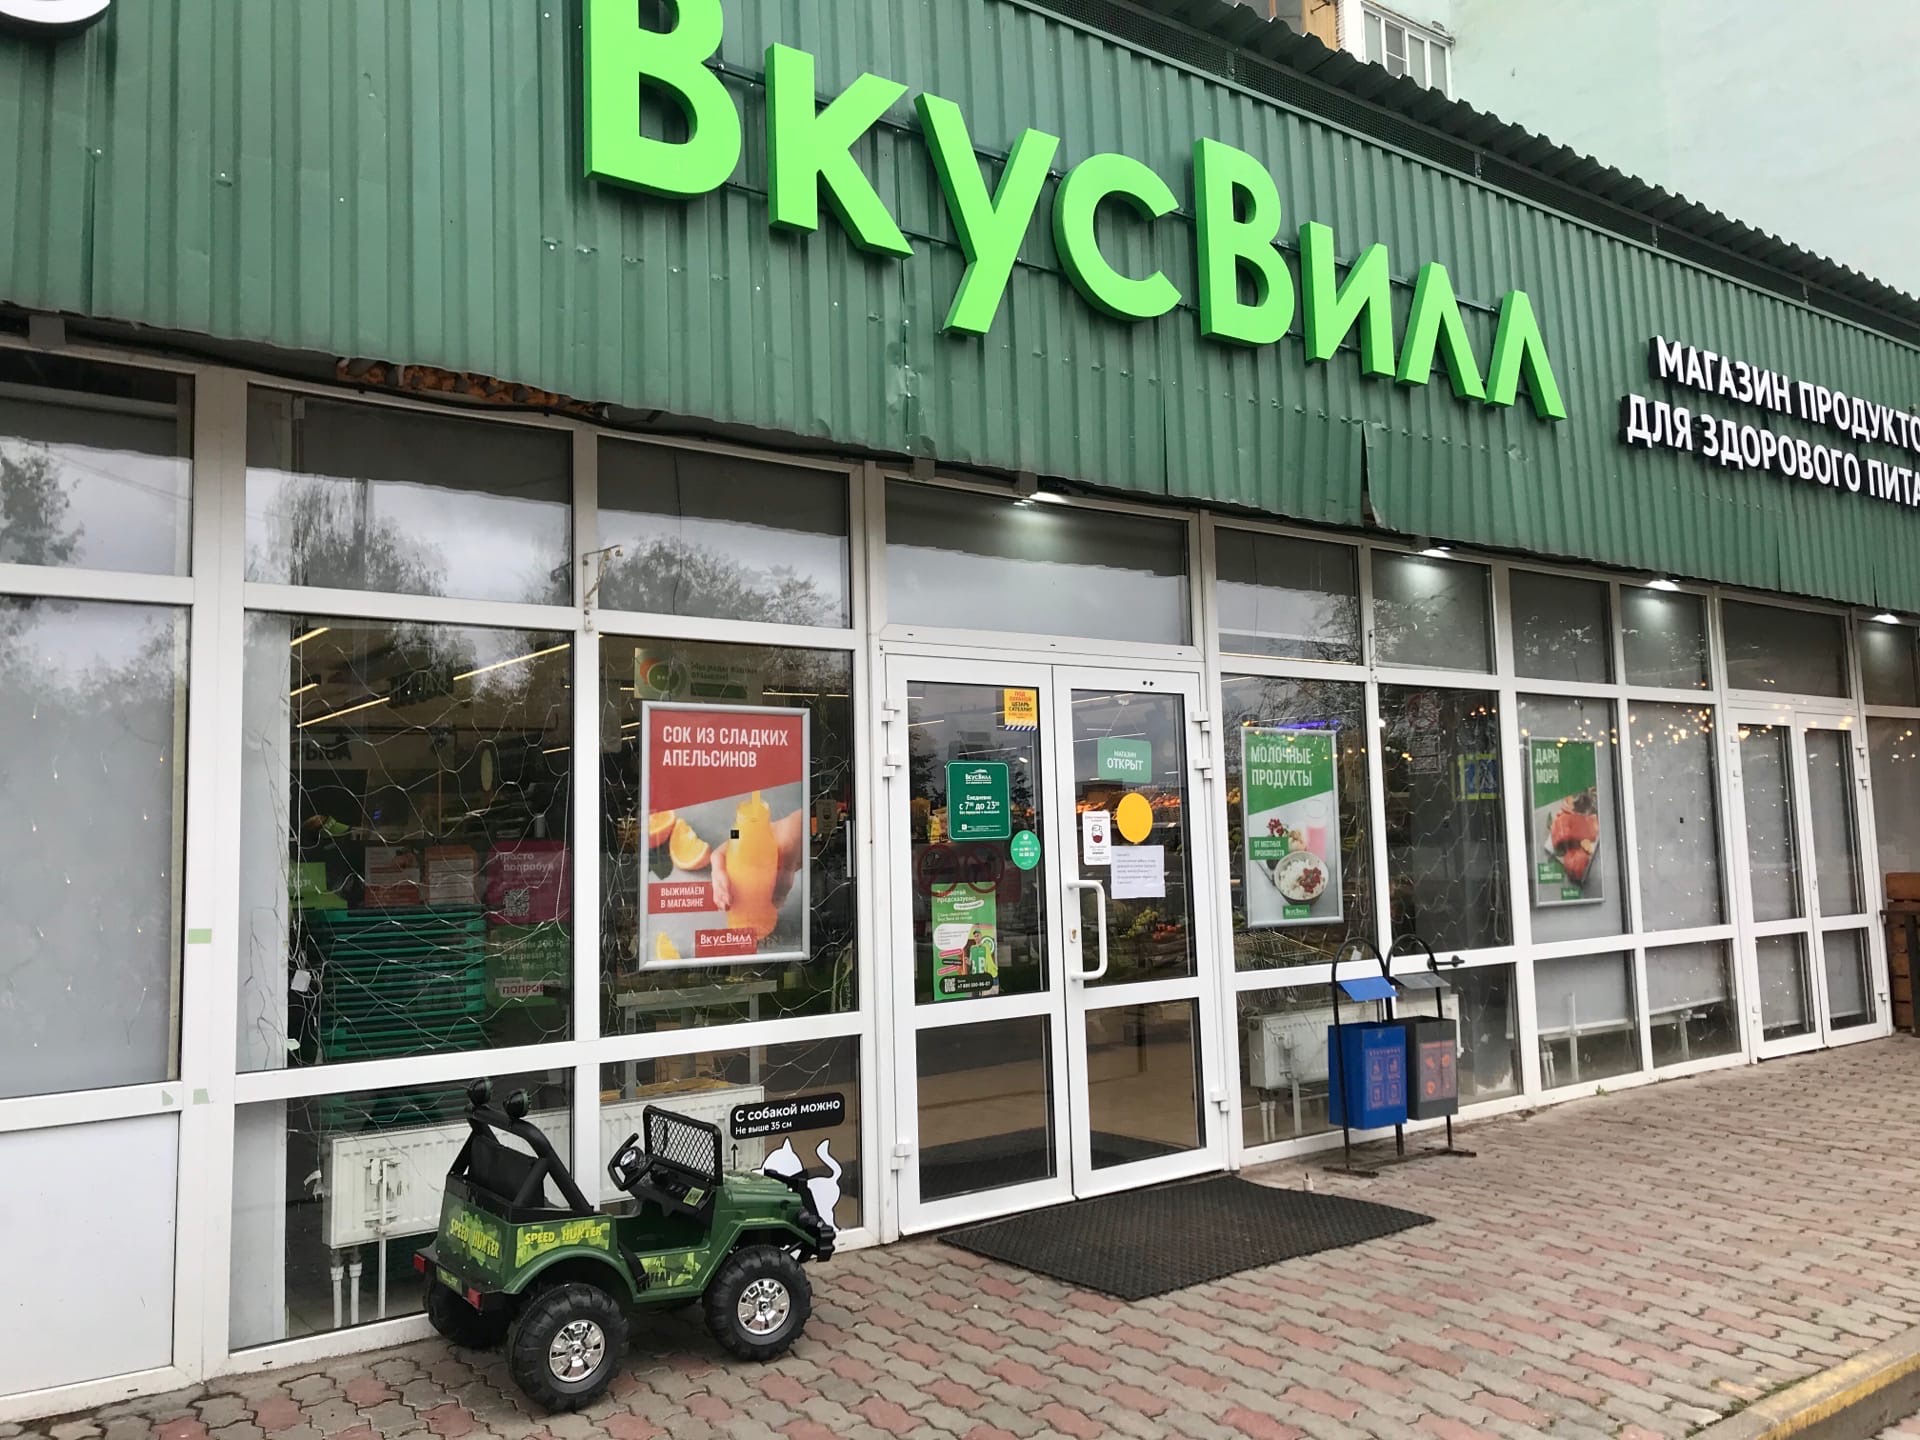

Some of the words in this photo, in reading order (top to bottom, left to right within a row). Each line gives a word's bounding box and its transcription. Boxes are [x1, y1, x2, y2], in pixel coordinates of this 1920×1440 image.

[584, 0, 1567, 421] ВкусВилл
[1655, 335, 1792, 414] МАГАЗИН
[1627, 393, 1693, 449] ДЛЯ
[1702, 414, 1861, 492] ЗДОРОВОГО
[662, 726, 691, 743] СОК
[697, 727, 715, 744] ИЗ
[720, 728, 788, 748] СЛАДКИХ
[662, 749, 757, 768] АПЕЛЬСИНОВ
[1251, 746, 1311, 764] МОЛОЧНЫЕ
[1535, 748, 1560, 766] ДАРЫ
[1107, 758, 1144, 771] ОТКРЫТ
[1252, 769, 1312, 789] ПРОДУКТЫ
[1536, 769, 1559, 784] МОРЯ
[975, 803, 985, 811] до
[660, 886, 705, 897] ВЫЖИМАЕМ
[660, 899, 666, 908] В
[667, 898, 704, 908] МАГАЗИНЕ
[700, 933, 752, 945] ВкусВилл
[735, 1110, 745, 1122] С
[747, 1103, 797, 1121] собакой
[800, 1100, 841, 1114] можно
[735, 1126, 746, 1135] Не
[748, 1124, 770, 1134] выше
[771, 1121, 780, 1130] 35
[782, 1121, 792, 1129] см
[451, 1218, 469, 1243] SPEED
[524, 1231, 555, 1244] SPEED
